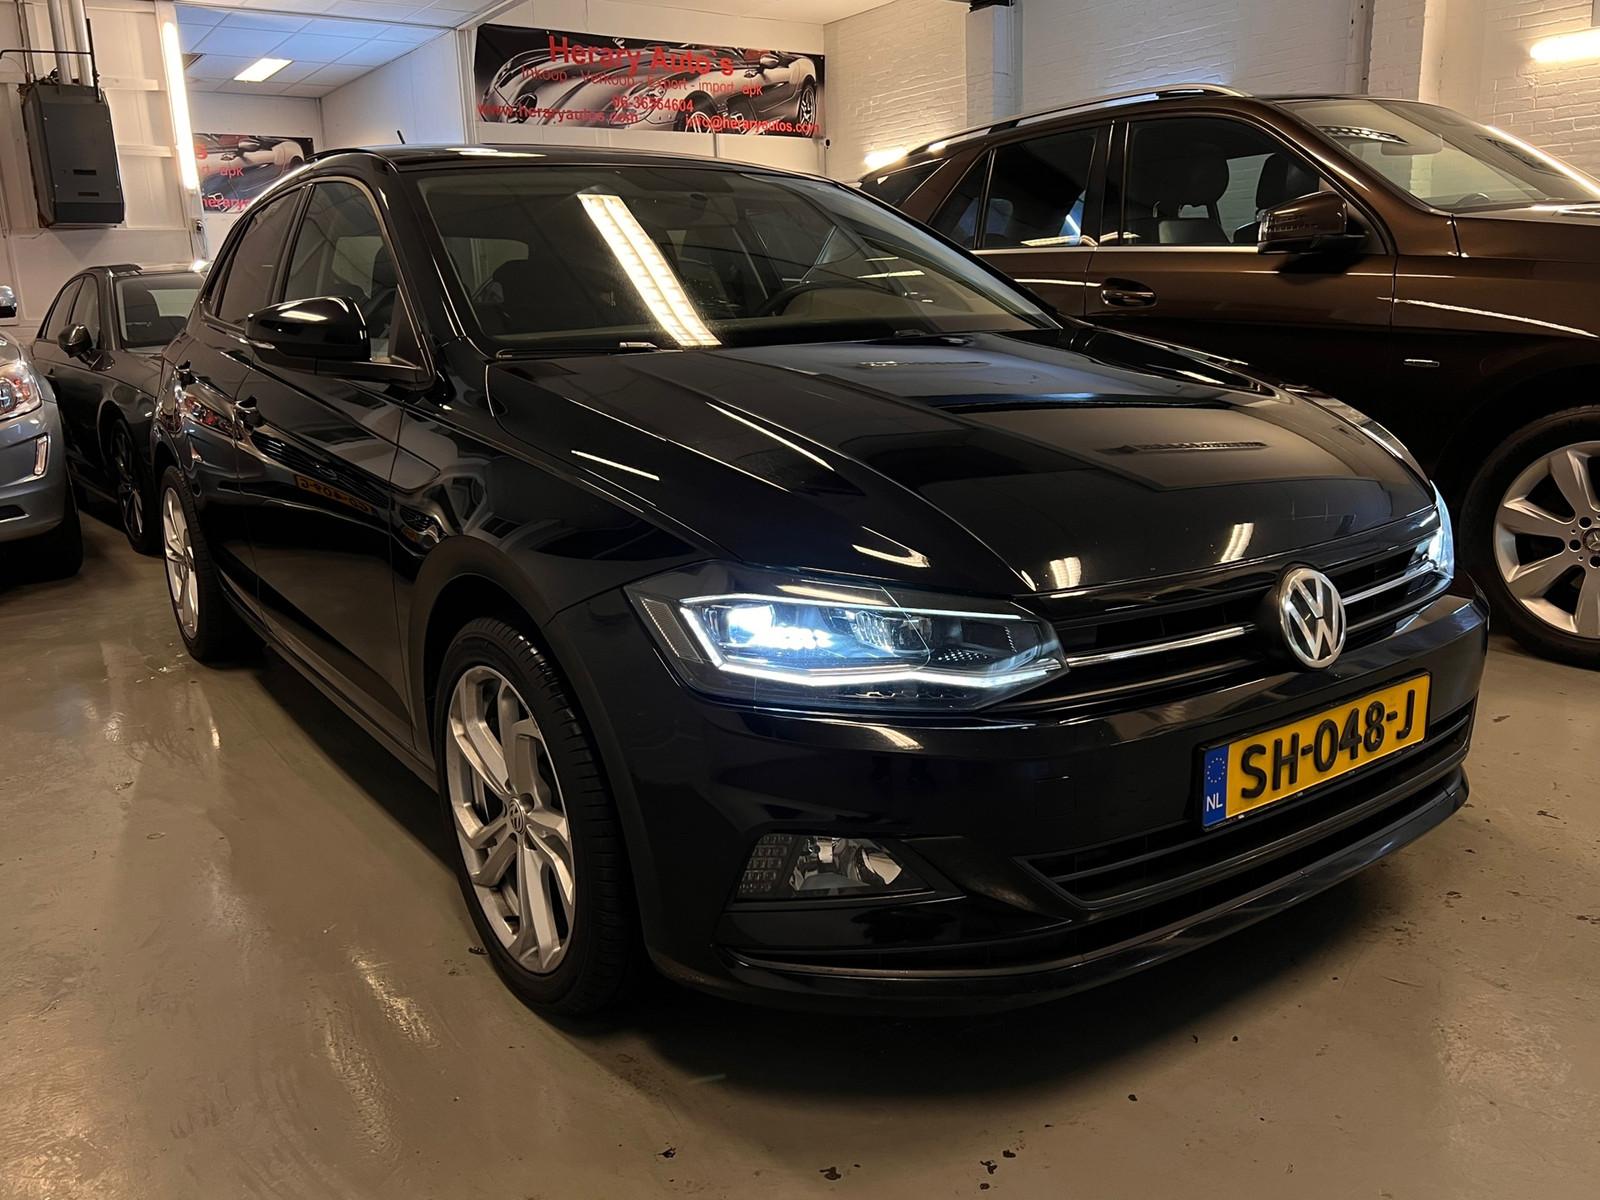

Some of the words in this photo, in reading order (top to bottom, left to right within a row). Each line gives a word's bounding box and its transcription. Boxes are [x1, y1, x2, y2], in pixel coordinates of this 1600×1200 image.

[548, 35, 641, 75] Herary
[741, 84, 764, 98] apk
[1240, 688, 1416, 799] SH-048-J
[1206, 792, 1223, 812] NL
